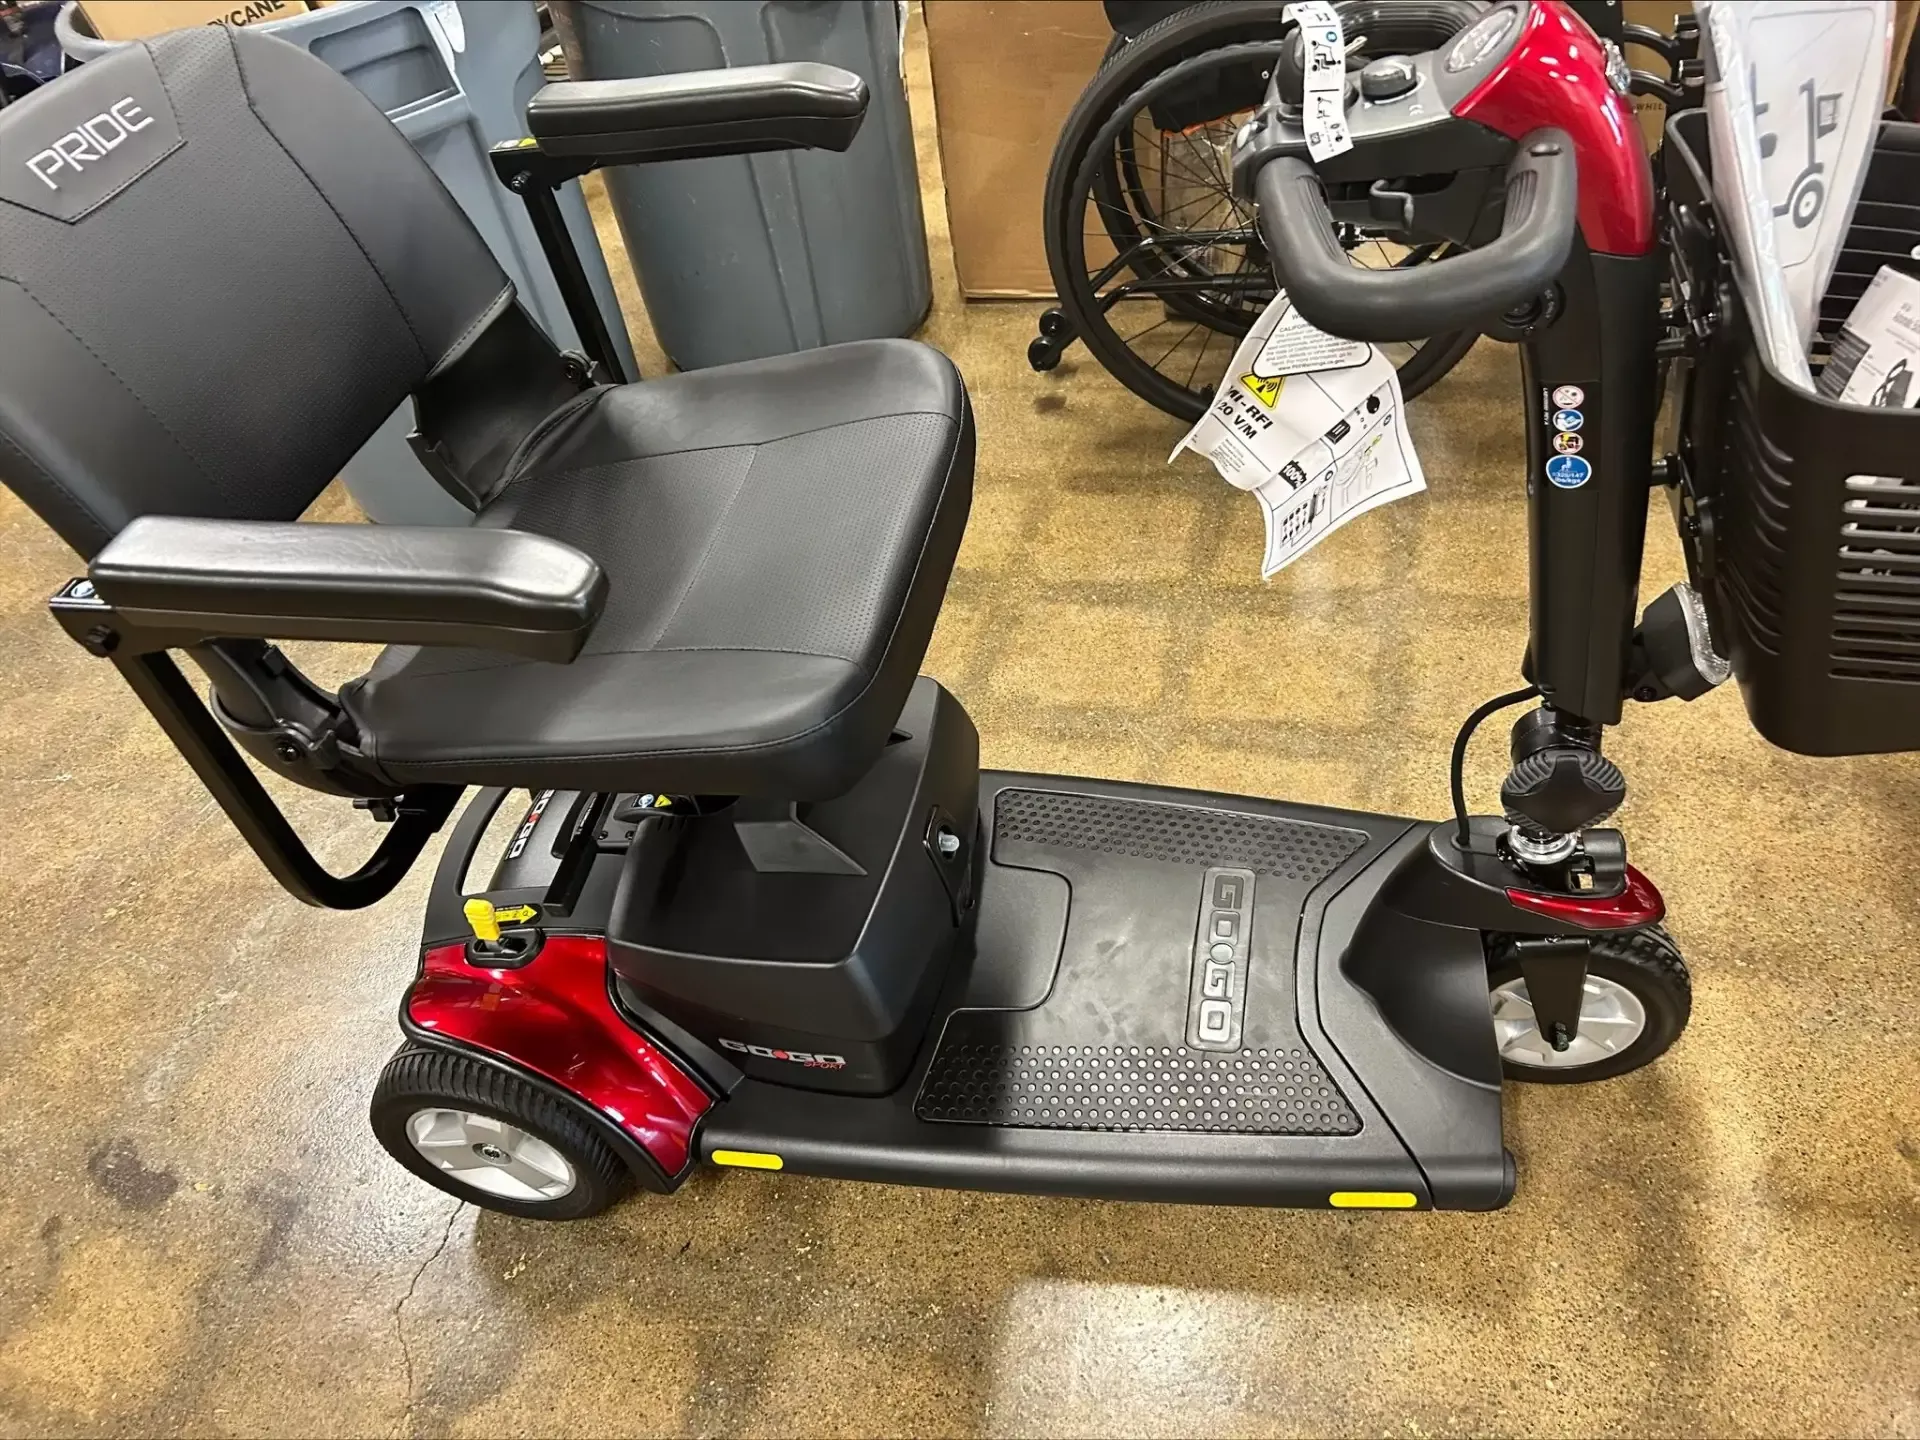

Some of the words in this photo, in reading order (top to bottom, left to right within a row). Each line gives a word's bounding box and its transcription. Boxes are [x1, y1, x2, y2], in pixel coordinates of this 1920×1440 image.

[26, 97, 155, 190] PRIDE
[1234, 415, 1257, 439] V/M
[1283, 465, 1303, 487] 100%
[804, 1061, 847, 1070] SPORT
